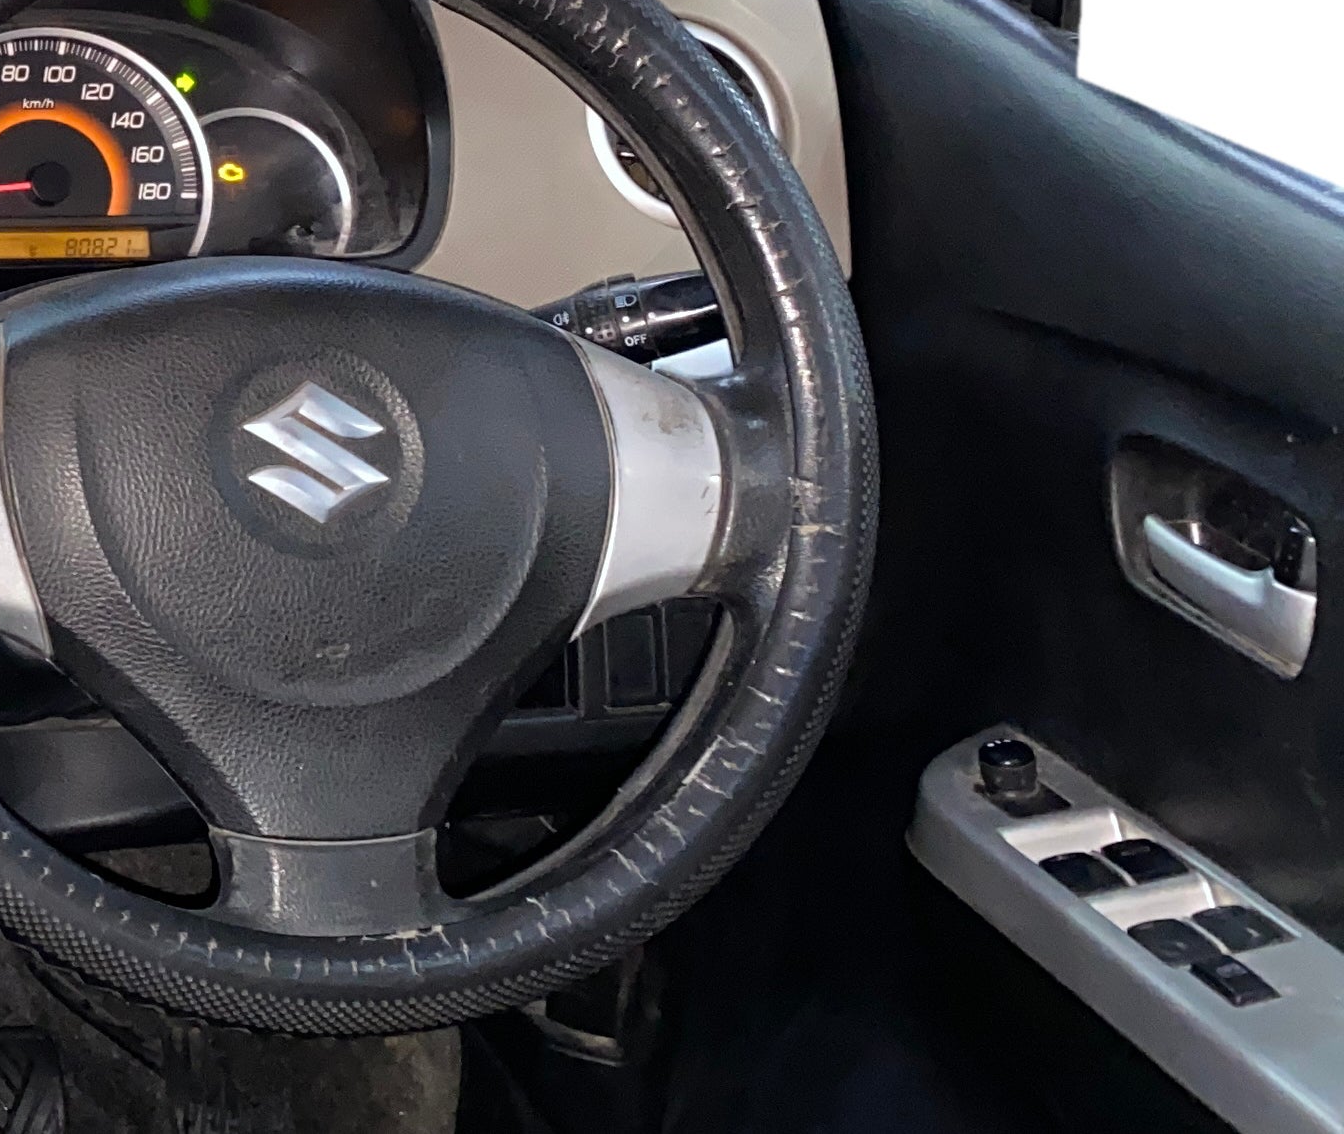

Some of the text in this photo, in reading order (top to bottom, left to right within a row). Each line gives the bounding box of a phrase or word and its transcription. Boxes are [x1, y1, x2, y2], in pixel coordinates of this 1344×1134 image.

[1, 65, 30, 83] 80
[43, 66, 76, 83] 100
[81, 84, 114, 101] 120
[22, 98, 55, 110] km/h
[111, 112, 145, 129] 140
[131, 146, 164, 163] 160
[138, 183, 171, 200] 180
[65, 238, 132, 257] 80821
[624, 334, 647, 347] OFF
